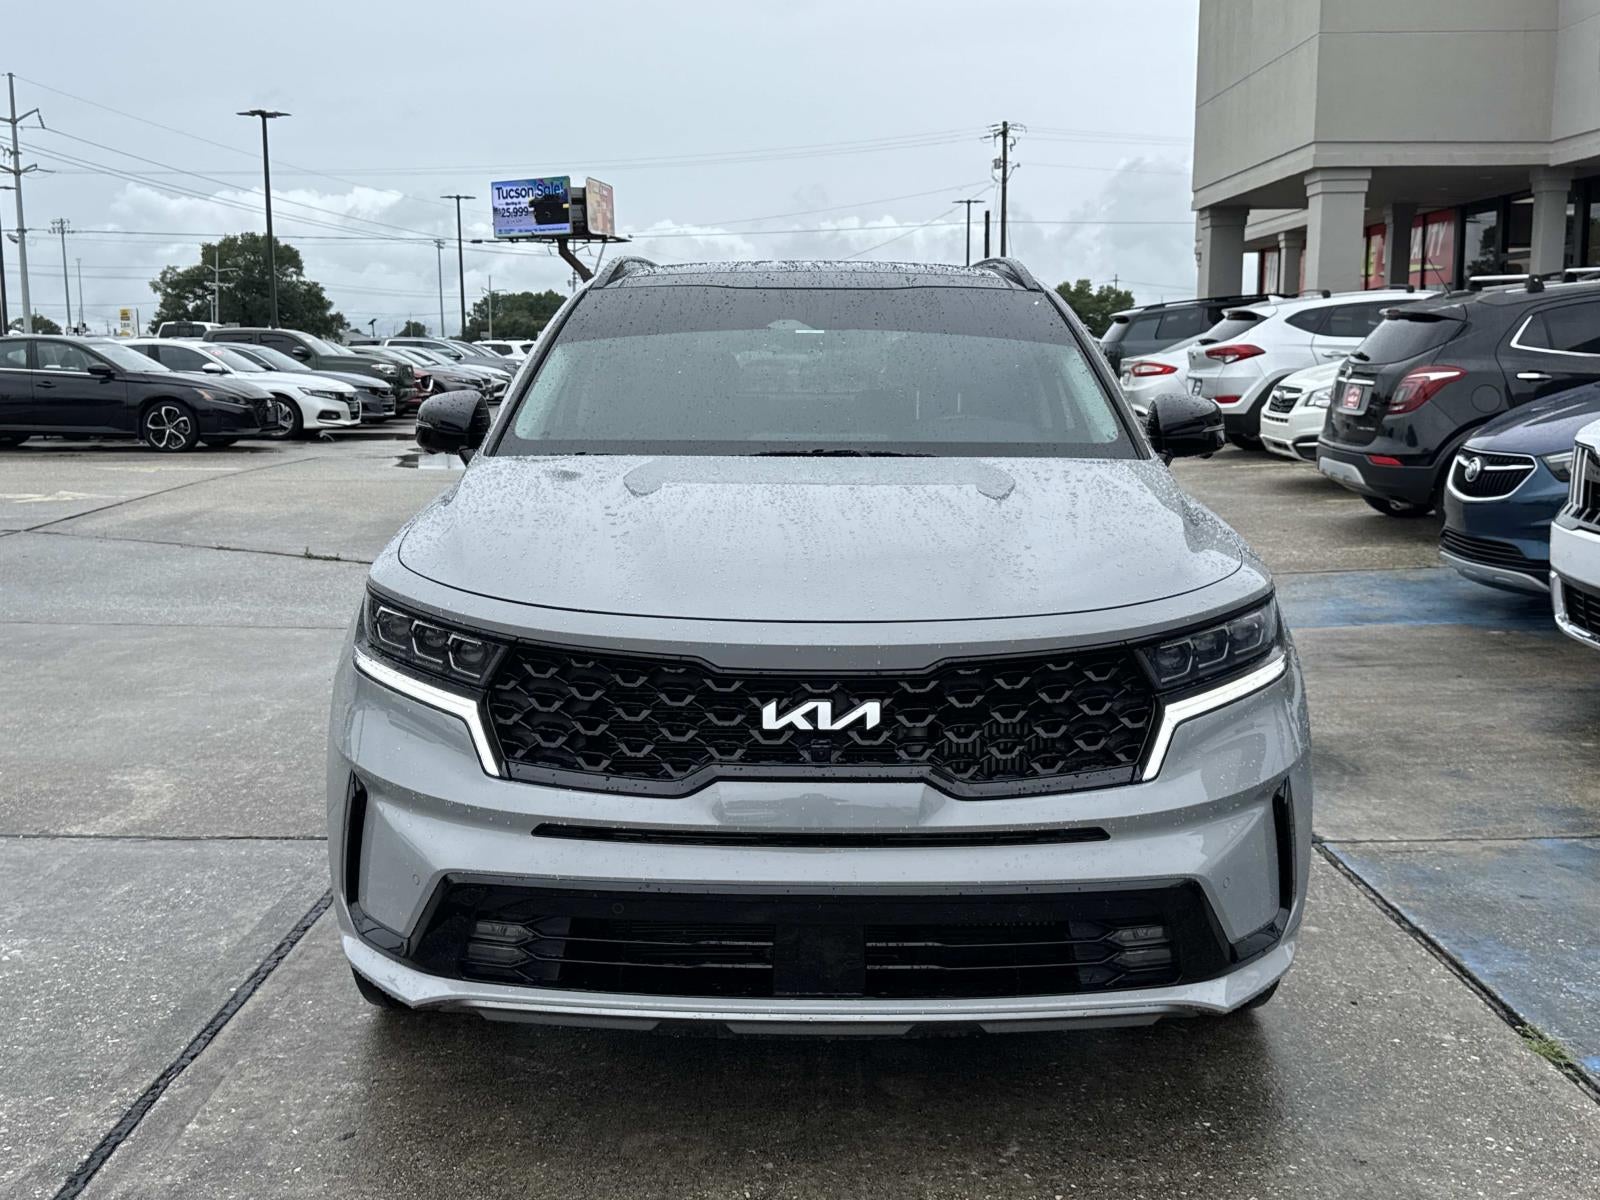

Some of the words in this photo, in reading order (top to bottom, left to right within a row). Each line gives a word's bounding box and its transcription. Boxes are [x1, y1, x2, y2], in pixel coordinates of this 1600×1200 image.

[496, 187, 534, 200] Tucson
[536, 182, 564, 196] Sale!
[762, 701, 881, 730] KIA
